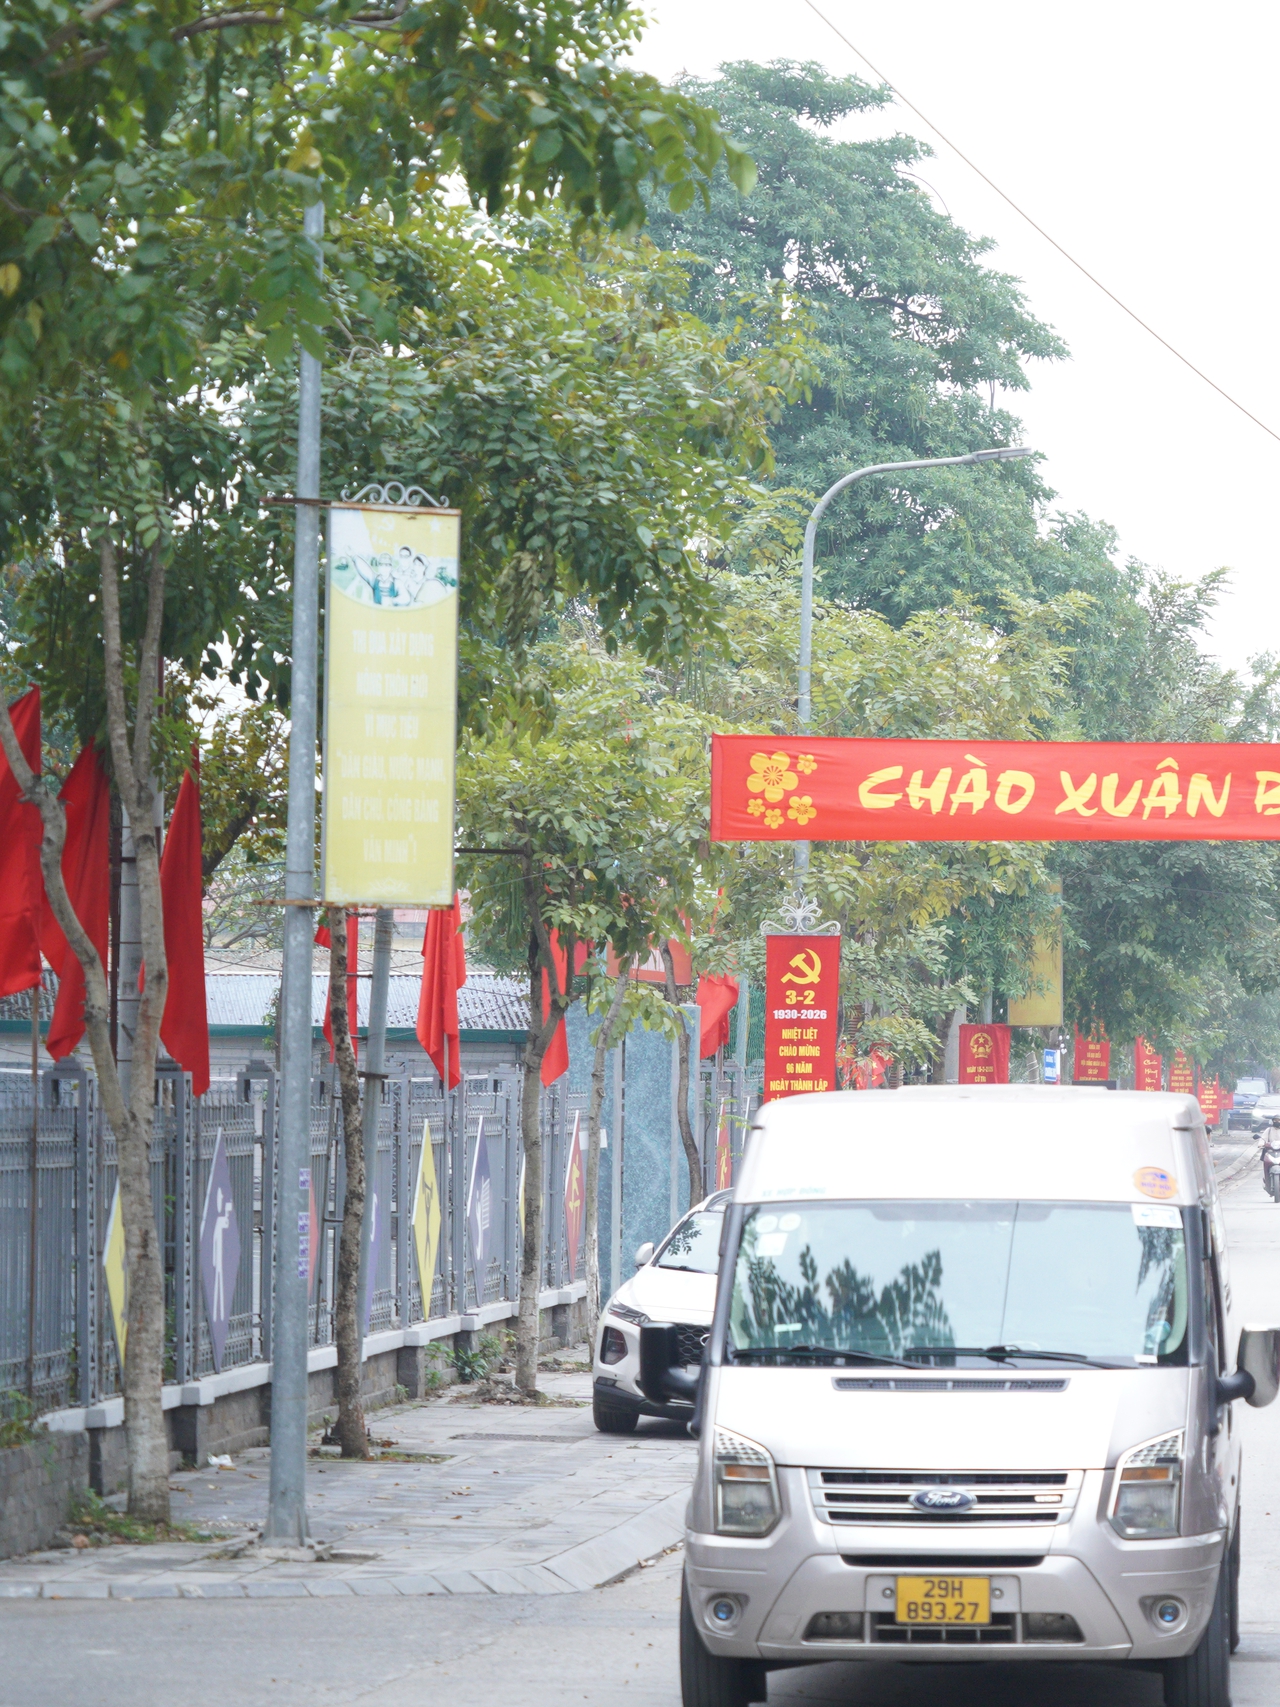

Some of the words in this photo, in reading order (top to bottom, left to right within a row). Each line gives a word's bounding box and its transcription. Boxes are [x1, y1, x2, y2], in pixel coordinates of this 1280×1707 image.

[858, 753, 1036, 816] CHÀO
[1054, 757, 1232, 820] XUÂN
[785, 990, 815, 1005] 3-2
[773, 1009, 827, 1019] 1930-2026
[782, 1027, 802, 1041] NHIỆT
[803, 1027, 818, 1041] LIỆT
[779, 1044, 797, 1056] CHÀO
[798, 1044, 820, 1056] MỪNG
[786, 1063, 794, 1073] 96
[796, 1061, 812, 1073] NĂM
[770, 1078, 788, 1091] NGÀY
[790, 1078, 812, 1091] THÀNH
[814, 1078, 828, 1092] LẬP
[925, 1490, 961, 1506] Ford
[924, 1580, 963, 1599] 29H
[907, 1601, 980, 1621] 893.27
